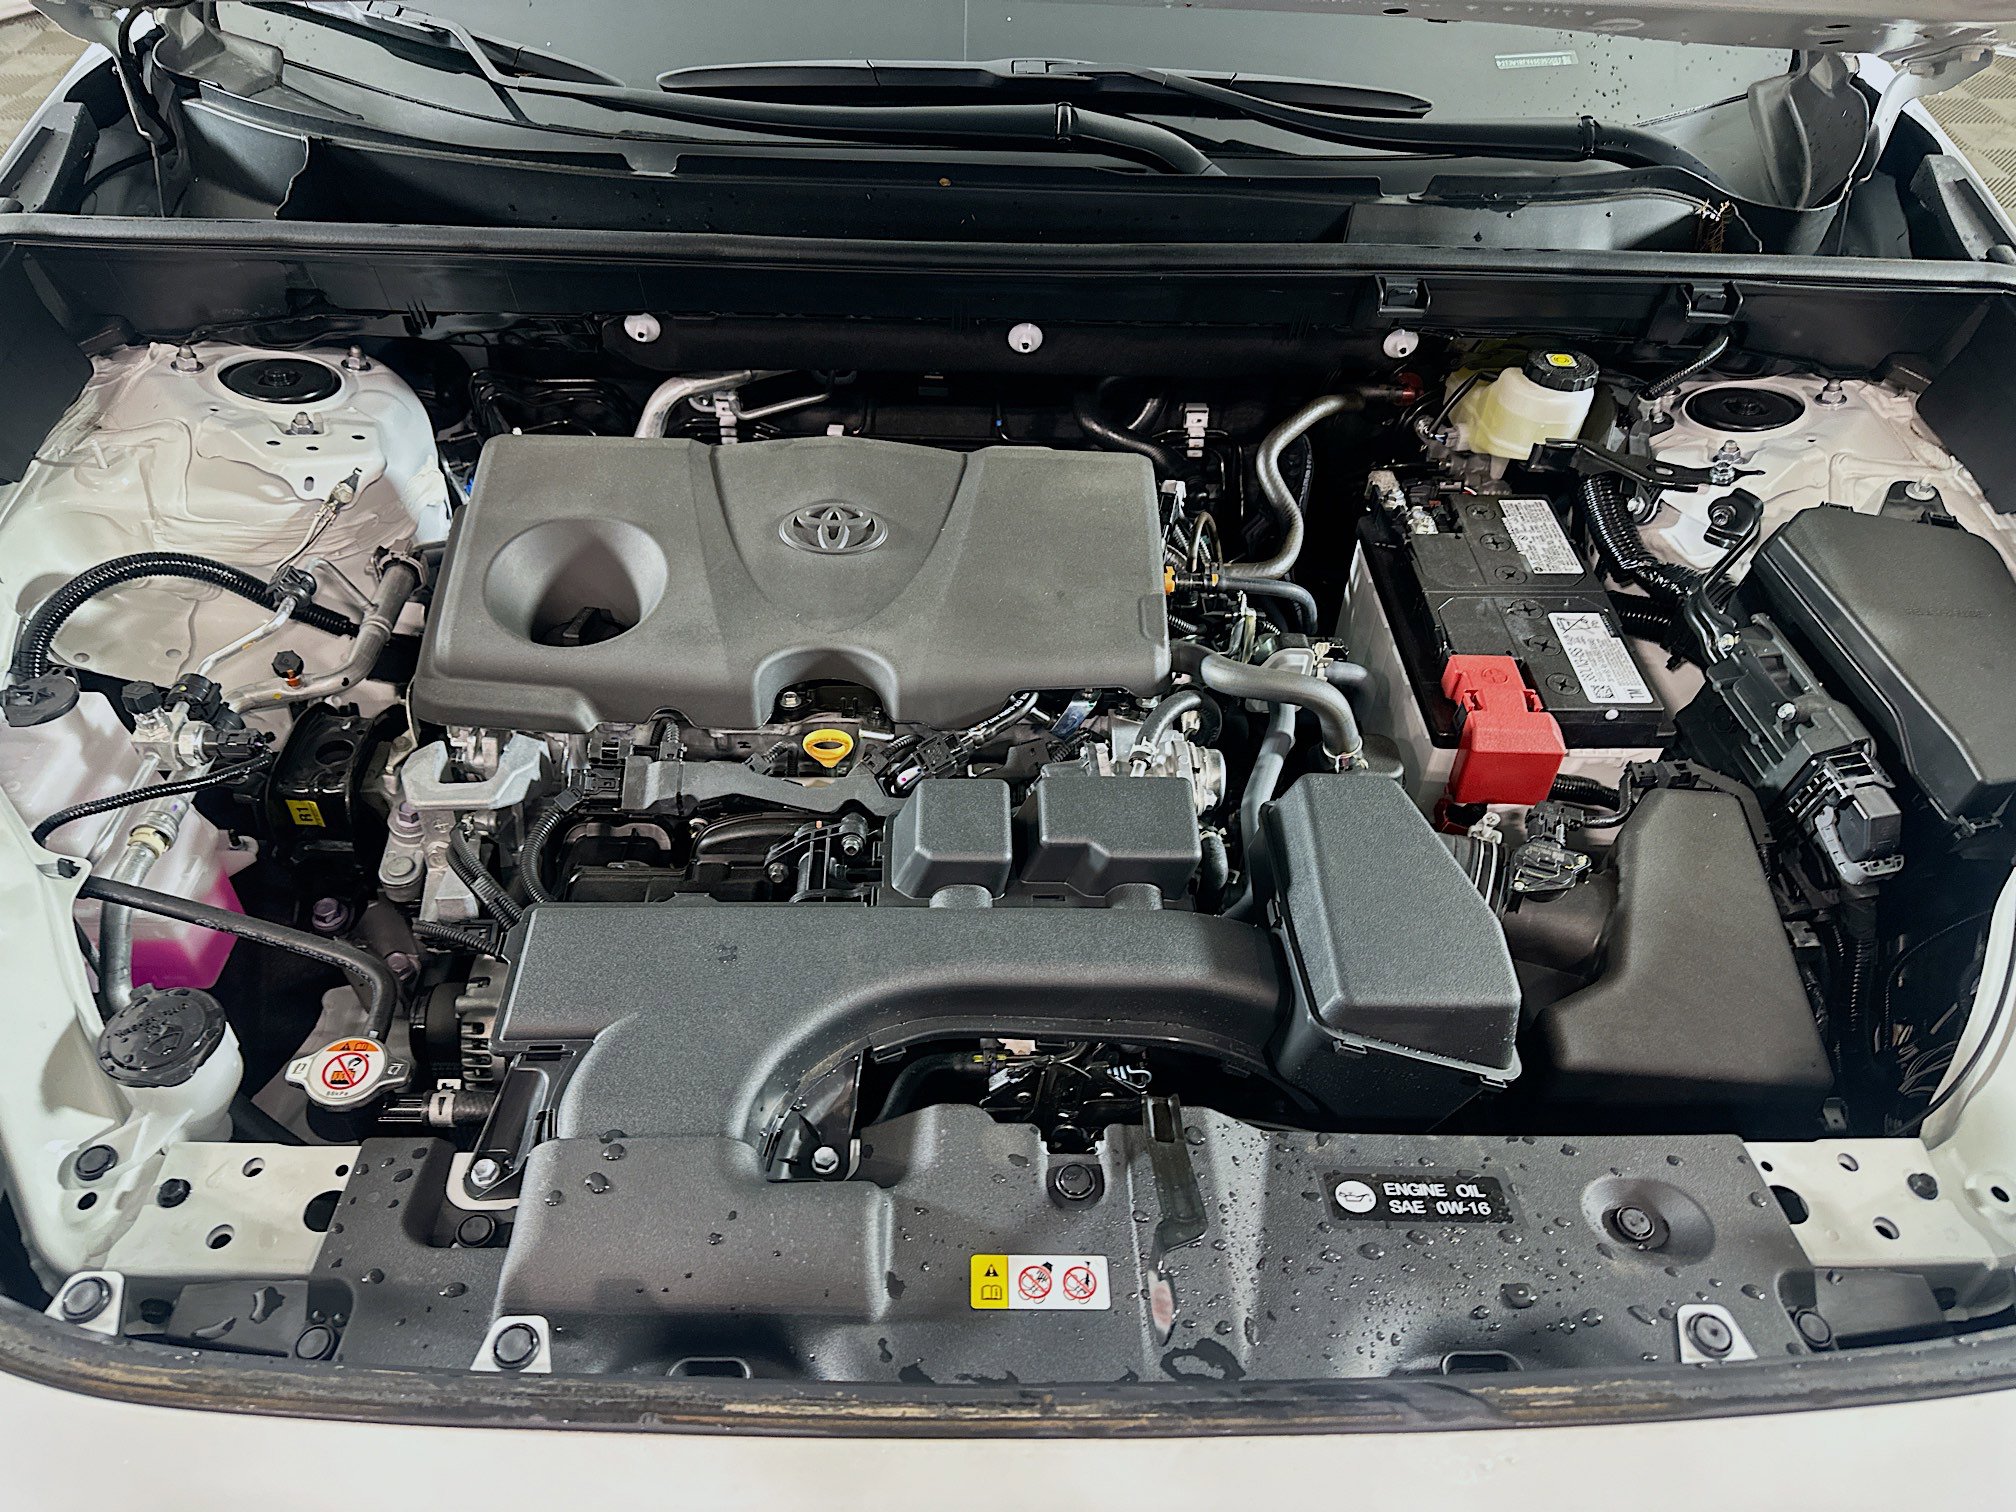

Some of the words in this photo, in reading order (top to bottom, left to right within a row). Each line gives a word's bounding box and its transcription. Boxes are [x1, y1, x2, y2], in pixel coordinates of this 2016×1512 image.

[296, 807, 314, 821] R1
[1382, 1182, 1448, 1198] ENGINE
[1455, 1184, 1487, 1198] OIL
[1388, 1200, 1427, 1214] SAE
[1436, 1201, 1492, 1216] 0W-16
